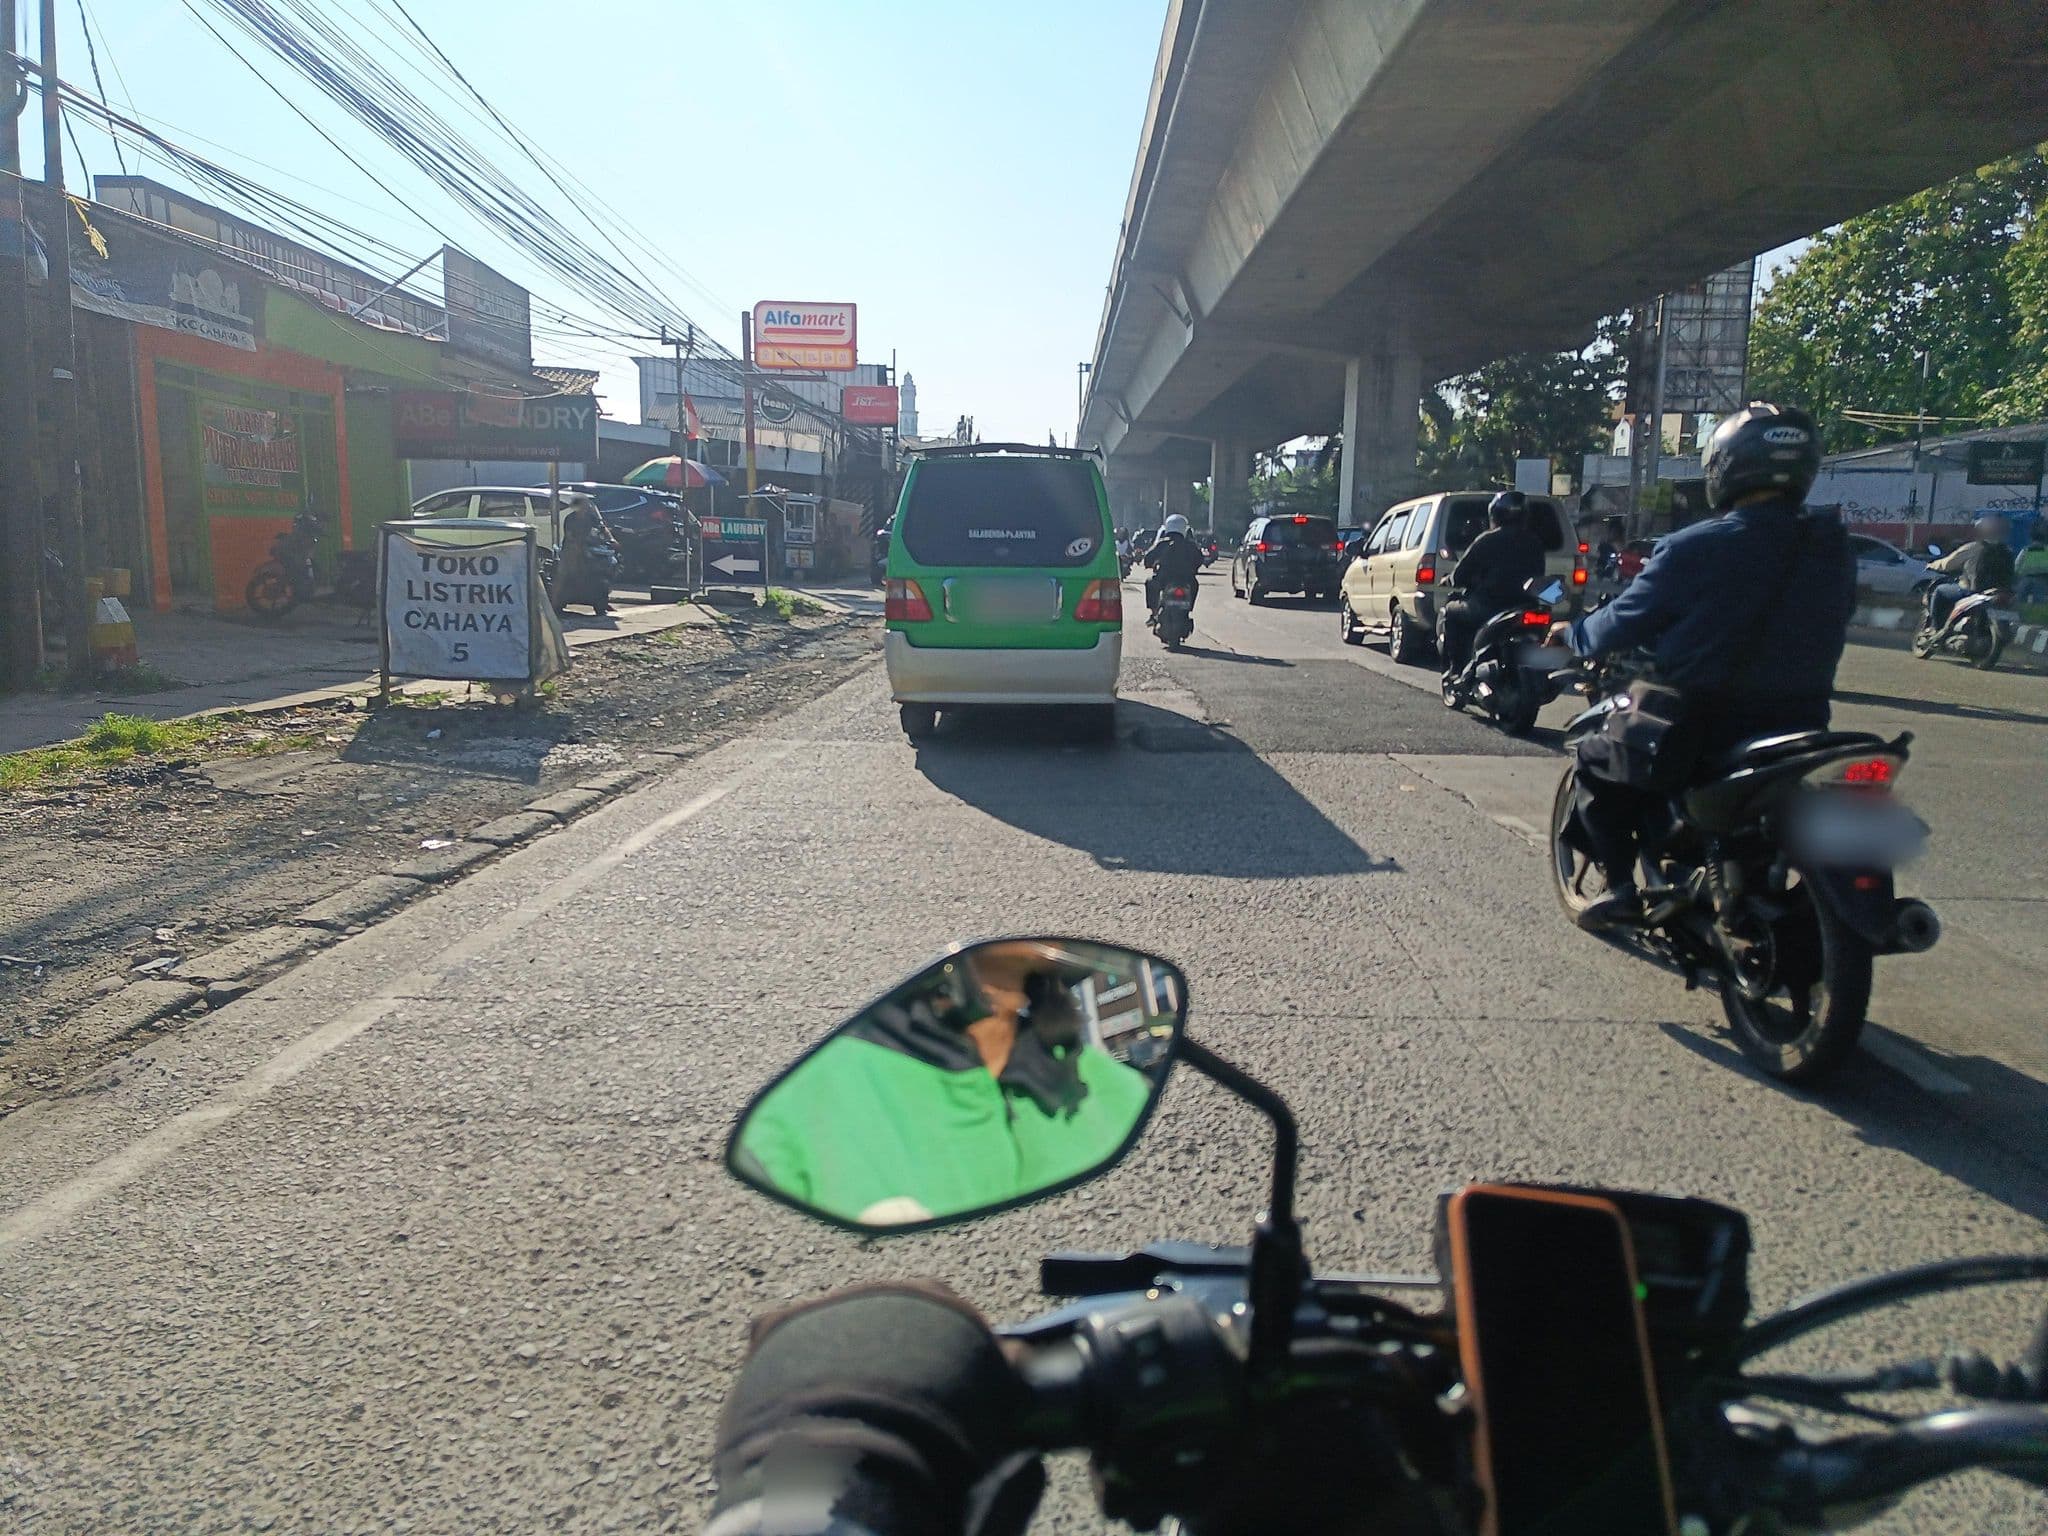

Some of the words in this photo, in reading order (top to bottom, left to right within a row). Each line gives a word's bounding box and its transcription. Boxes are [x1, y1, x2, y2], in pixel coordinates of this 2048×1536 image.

[764, 310, 846, 326] Alfamart
[459, 406, 590, 430] LNDRY
[721, 521, 766, 535] LAUNDRY
[417, 552, 499, 576] TOKO
[407, 580, 514, 605] LISTRIK
[404, 609, 513, 633] CAHAYA
[452, 642, 470, 662] 5
